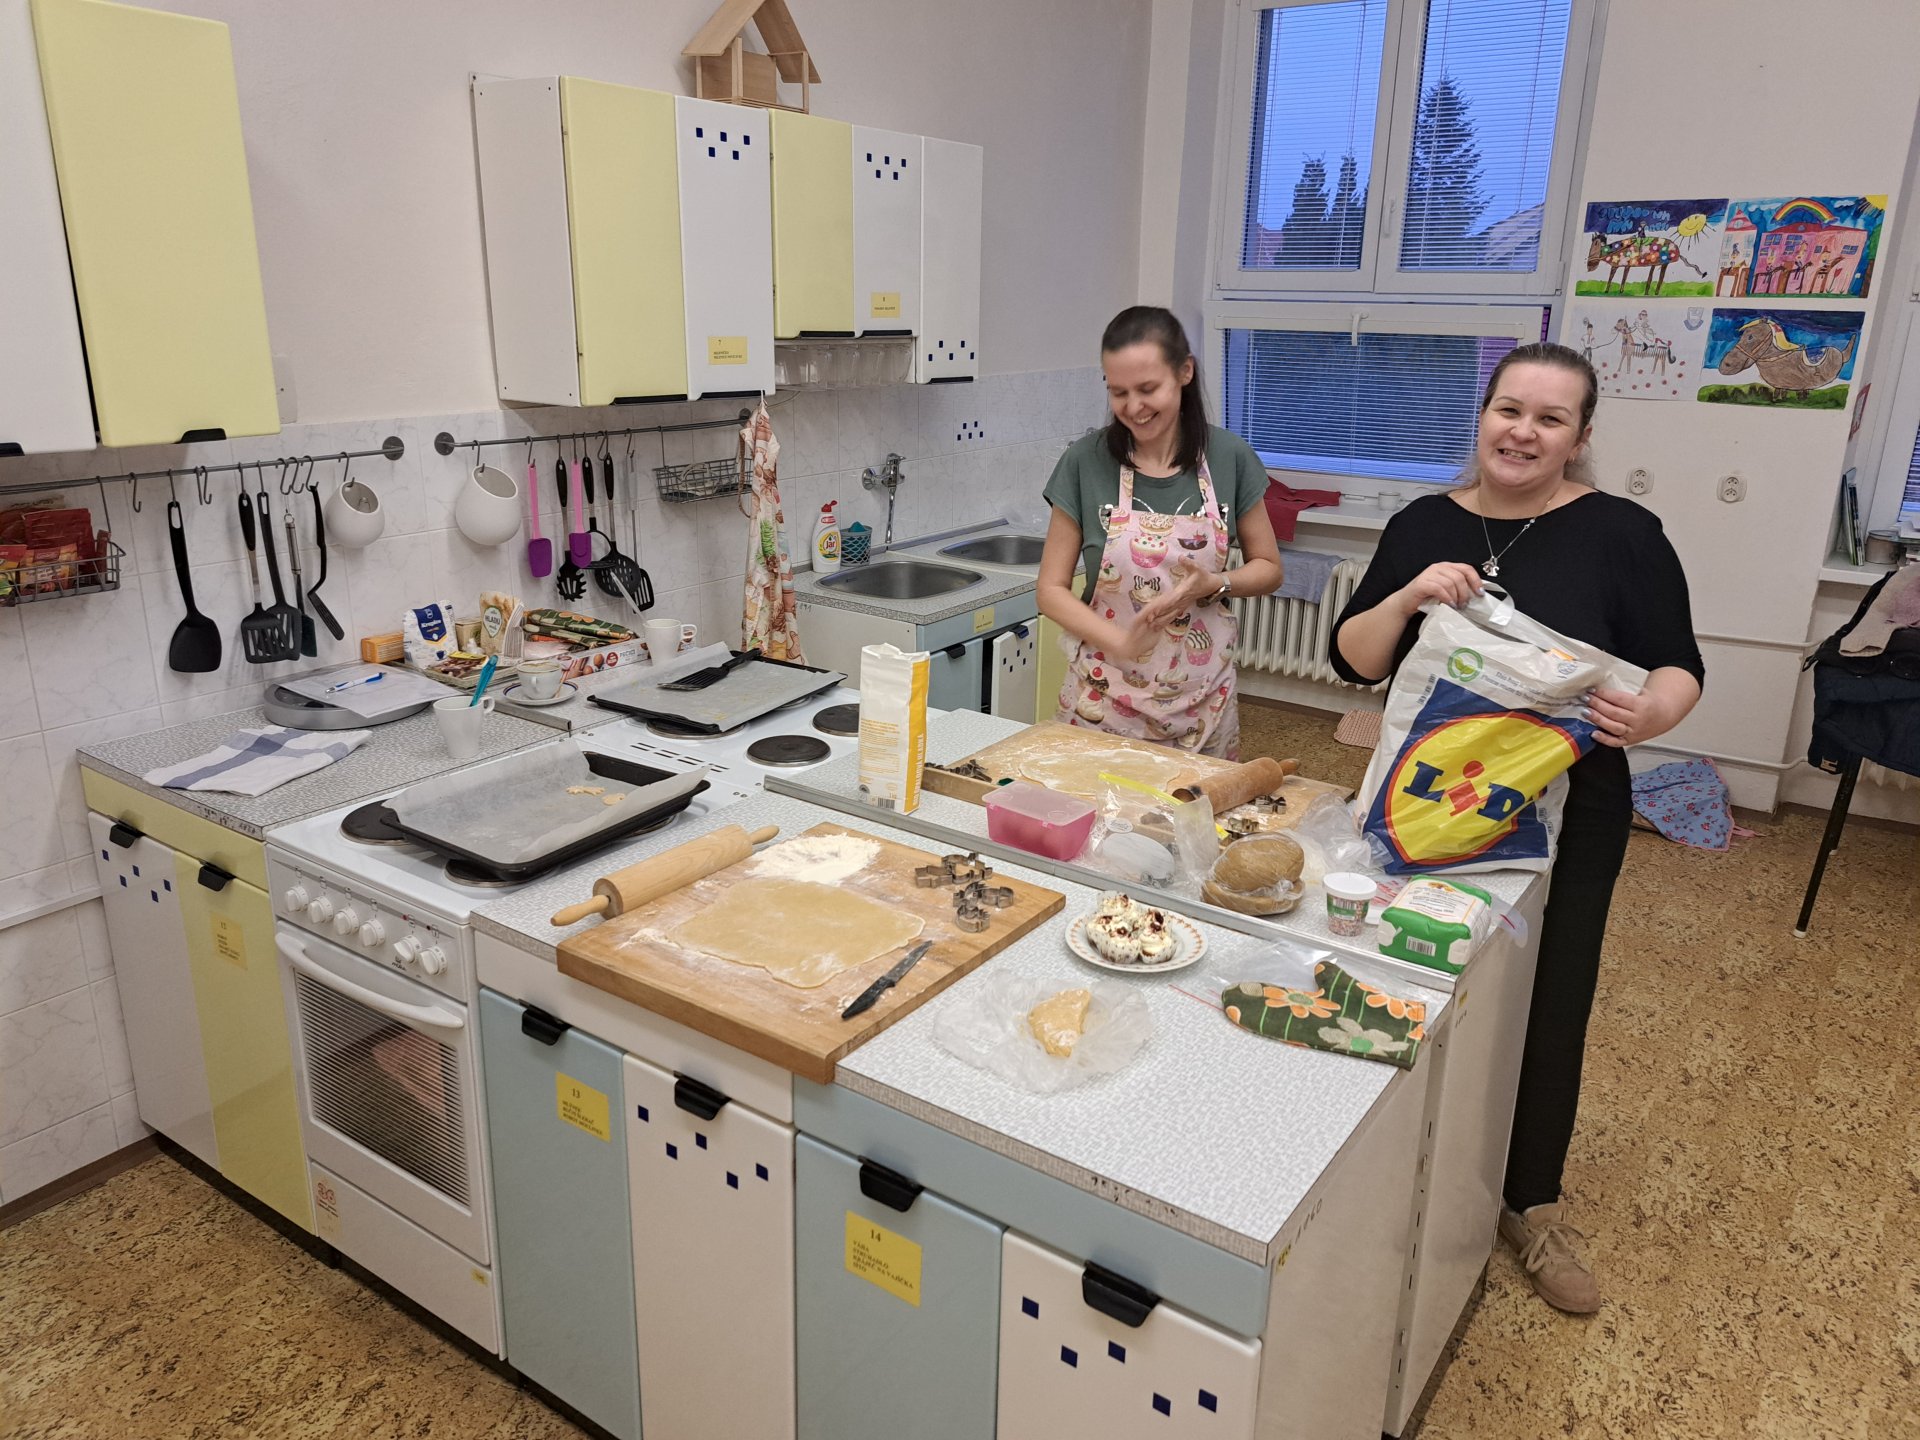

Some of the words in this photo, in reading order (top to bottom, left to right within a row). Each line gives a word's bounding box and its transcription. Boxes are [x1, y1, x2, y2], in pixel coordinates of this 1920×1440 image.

[826, 540, 835, 549] Jar
[572, 1088, 581, 1099] 13
[871, 1229, 881, 1242] 14
[853, 1247, 889, 1269] STRUHADLO
